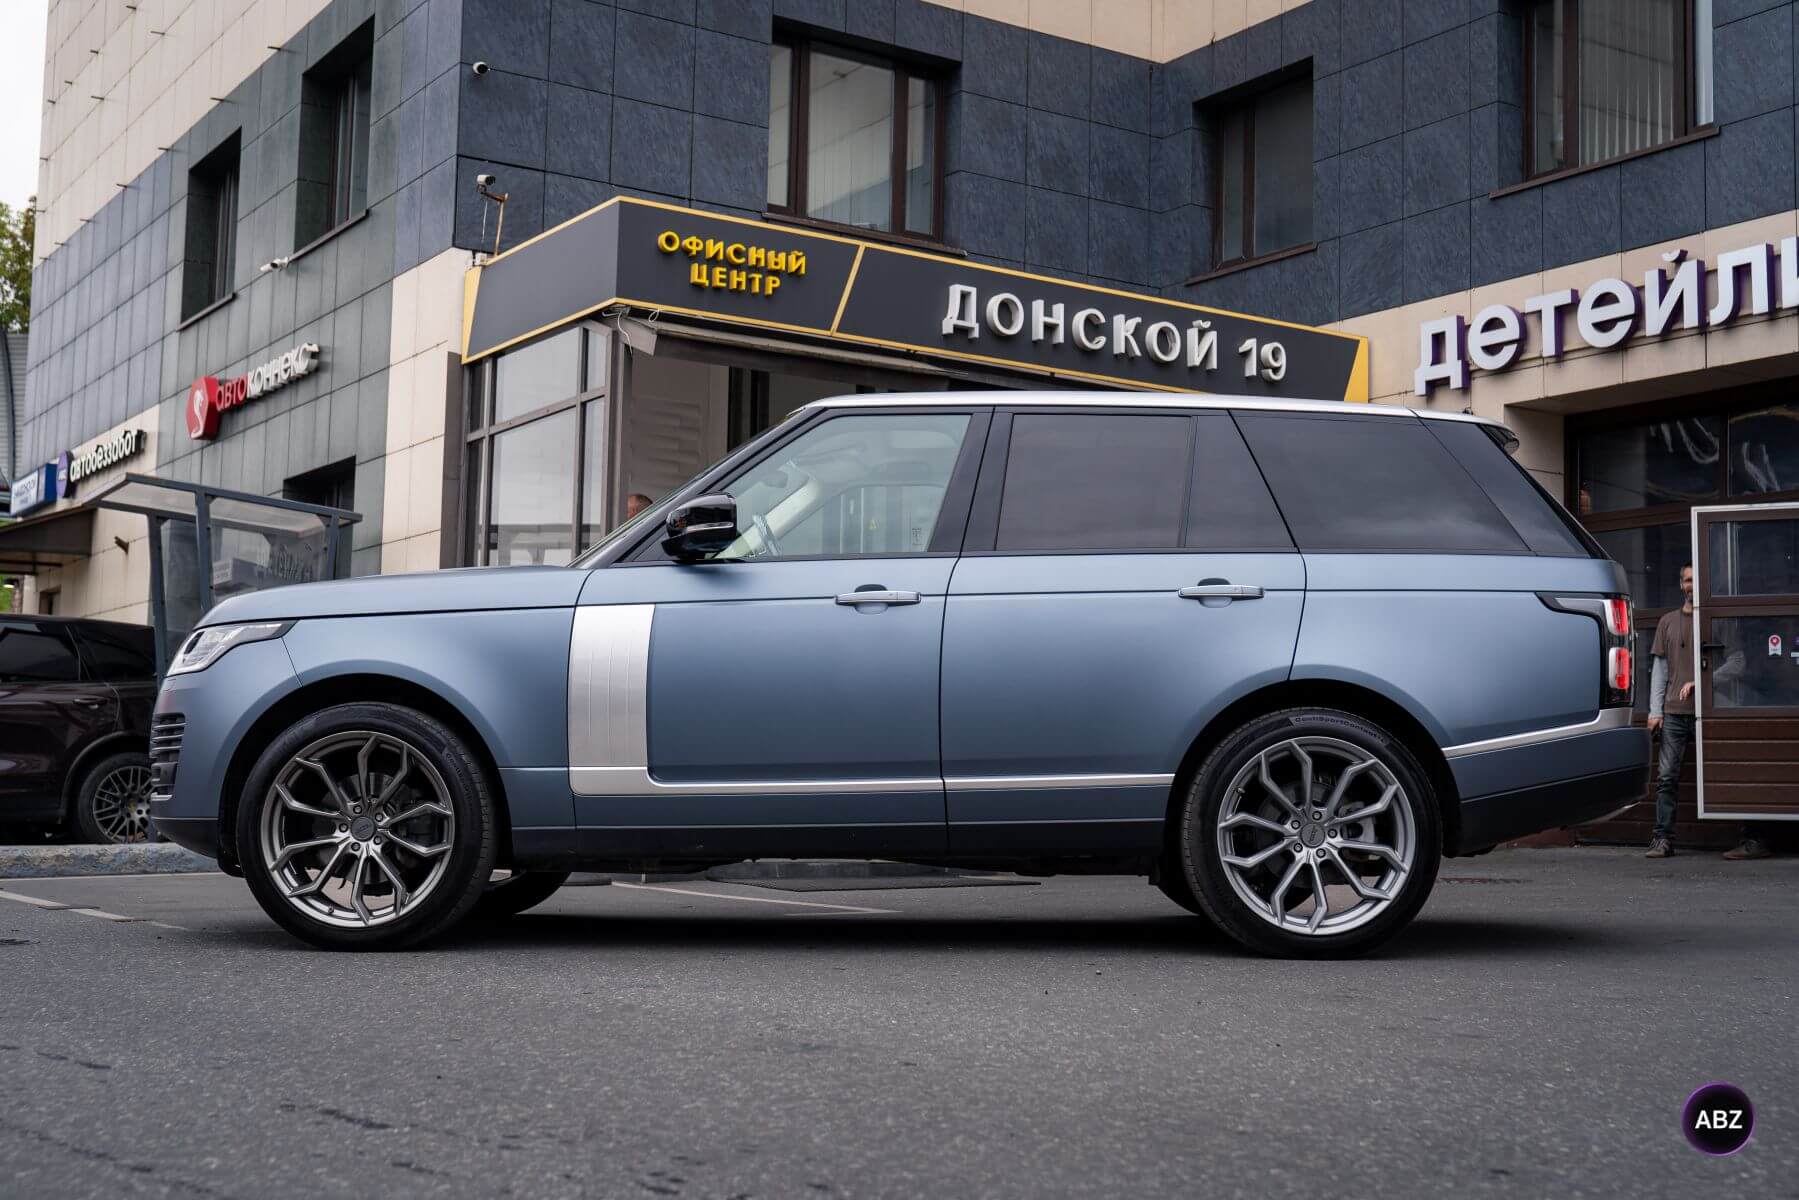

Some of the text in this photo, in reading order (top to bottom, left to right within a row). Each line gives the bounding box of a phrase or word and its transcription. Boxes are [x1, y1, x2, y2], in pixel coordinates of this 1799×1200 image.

[657, 230, 807, 276] ОФИСНЫЙ
[689, 262, 781, 297] ЦЕНТР
[941, 283, 1287, 383] ДОНСКОЙ 19
